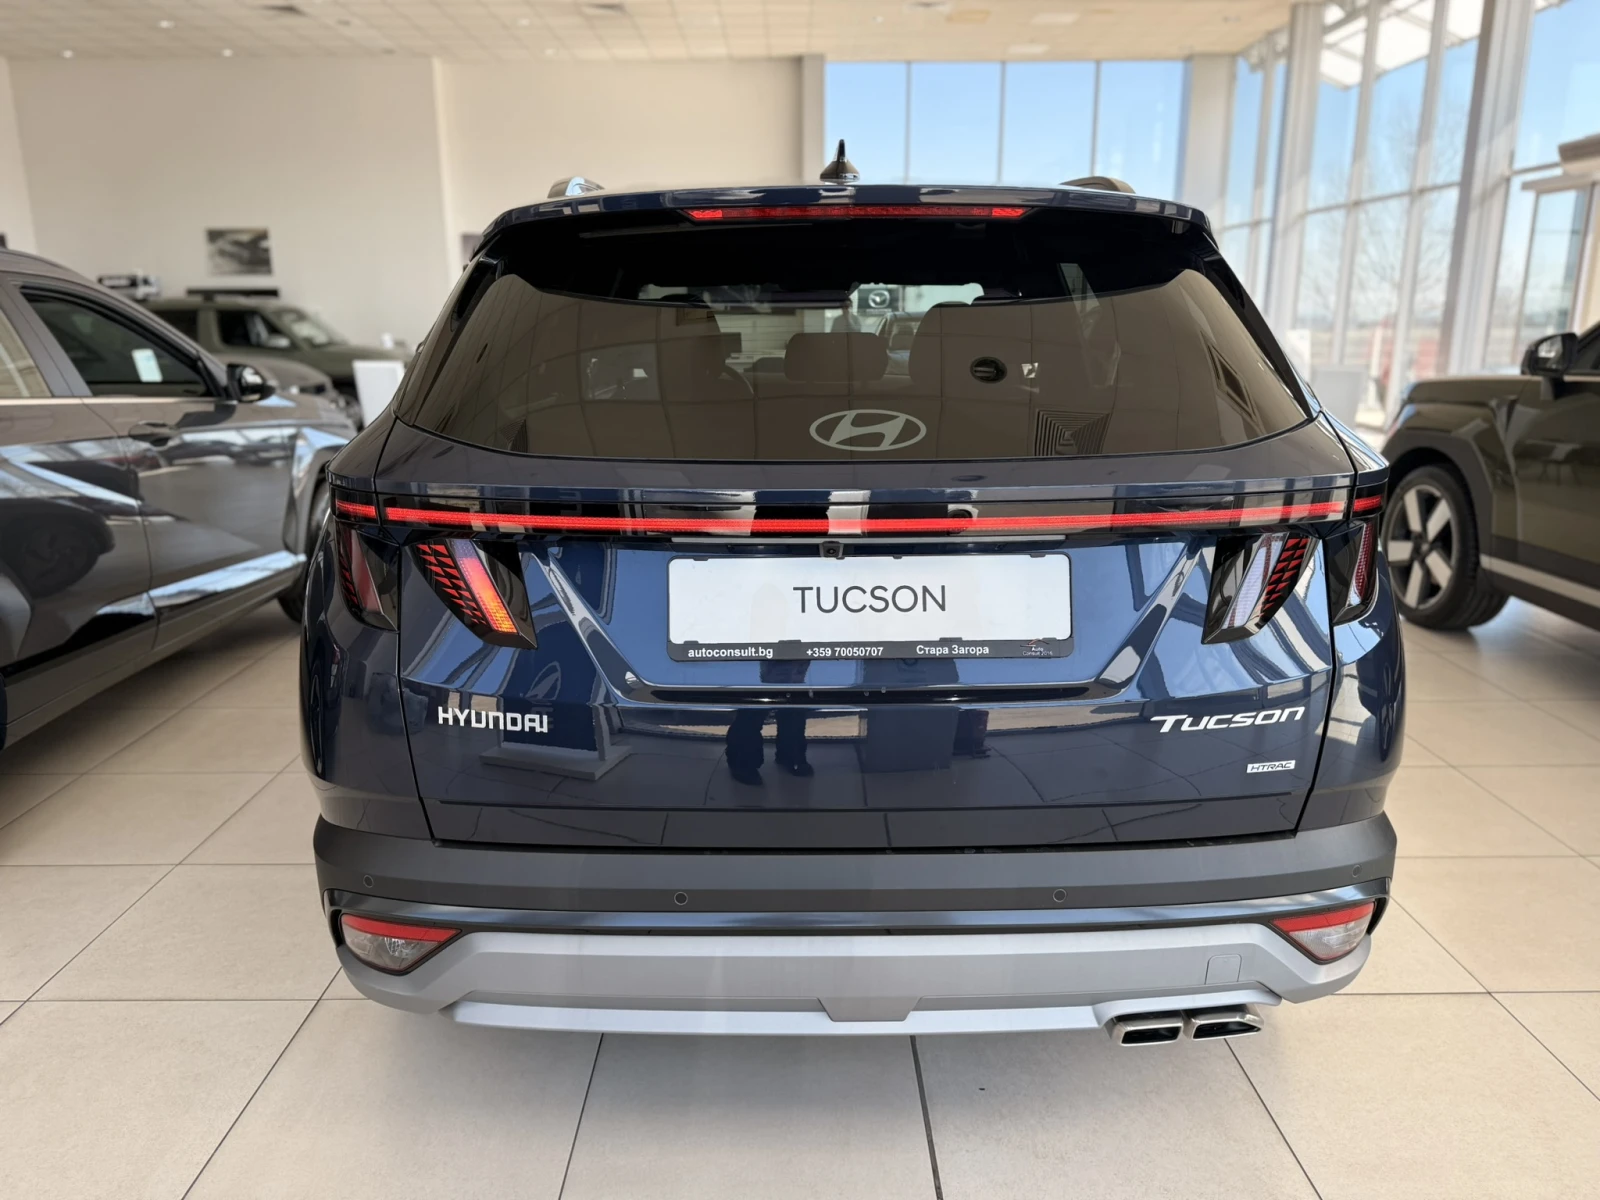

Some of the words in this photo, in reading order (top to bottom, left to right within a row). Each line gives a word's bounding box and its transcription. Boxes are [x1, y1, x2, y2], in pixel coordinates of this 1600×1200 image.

[793, 584, 947, 614] TUCSON
[687, 646, 774, 659] autoconsult.bg
[806, 647, 832, 657] +359
[834, 646, 884, 657] 70050707
[916, 645, 949, 656] Стара
[951, 645, 990, 656] Загора
[437, 706, 549, 733] HYUNDAI
[1250, 761, 1293, 772] HTRAC
